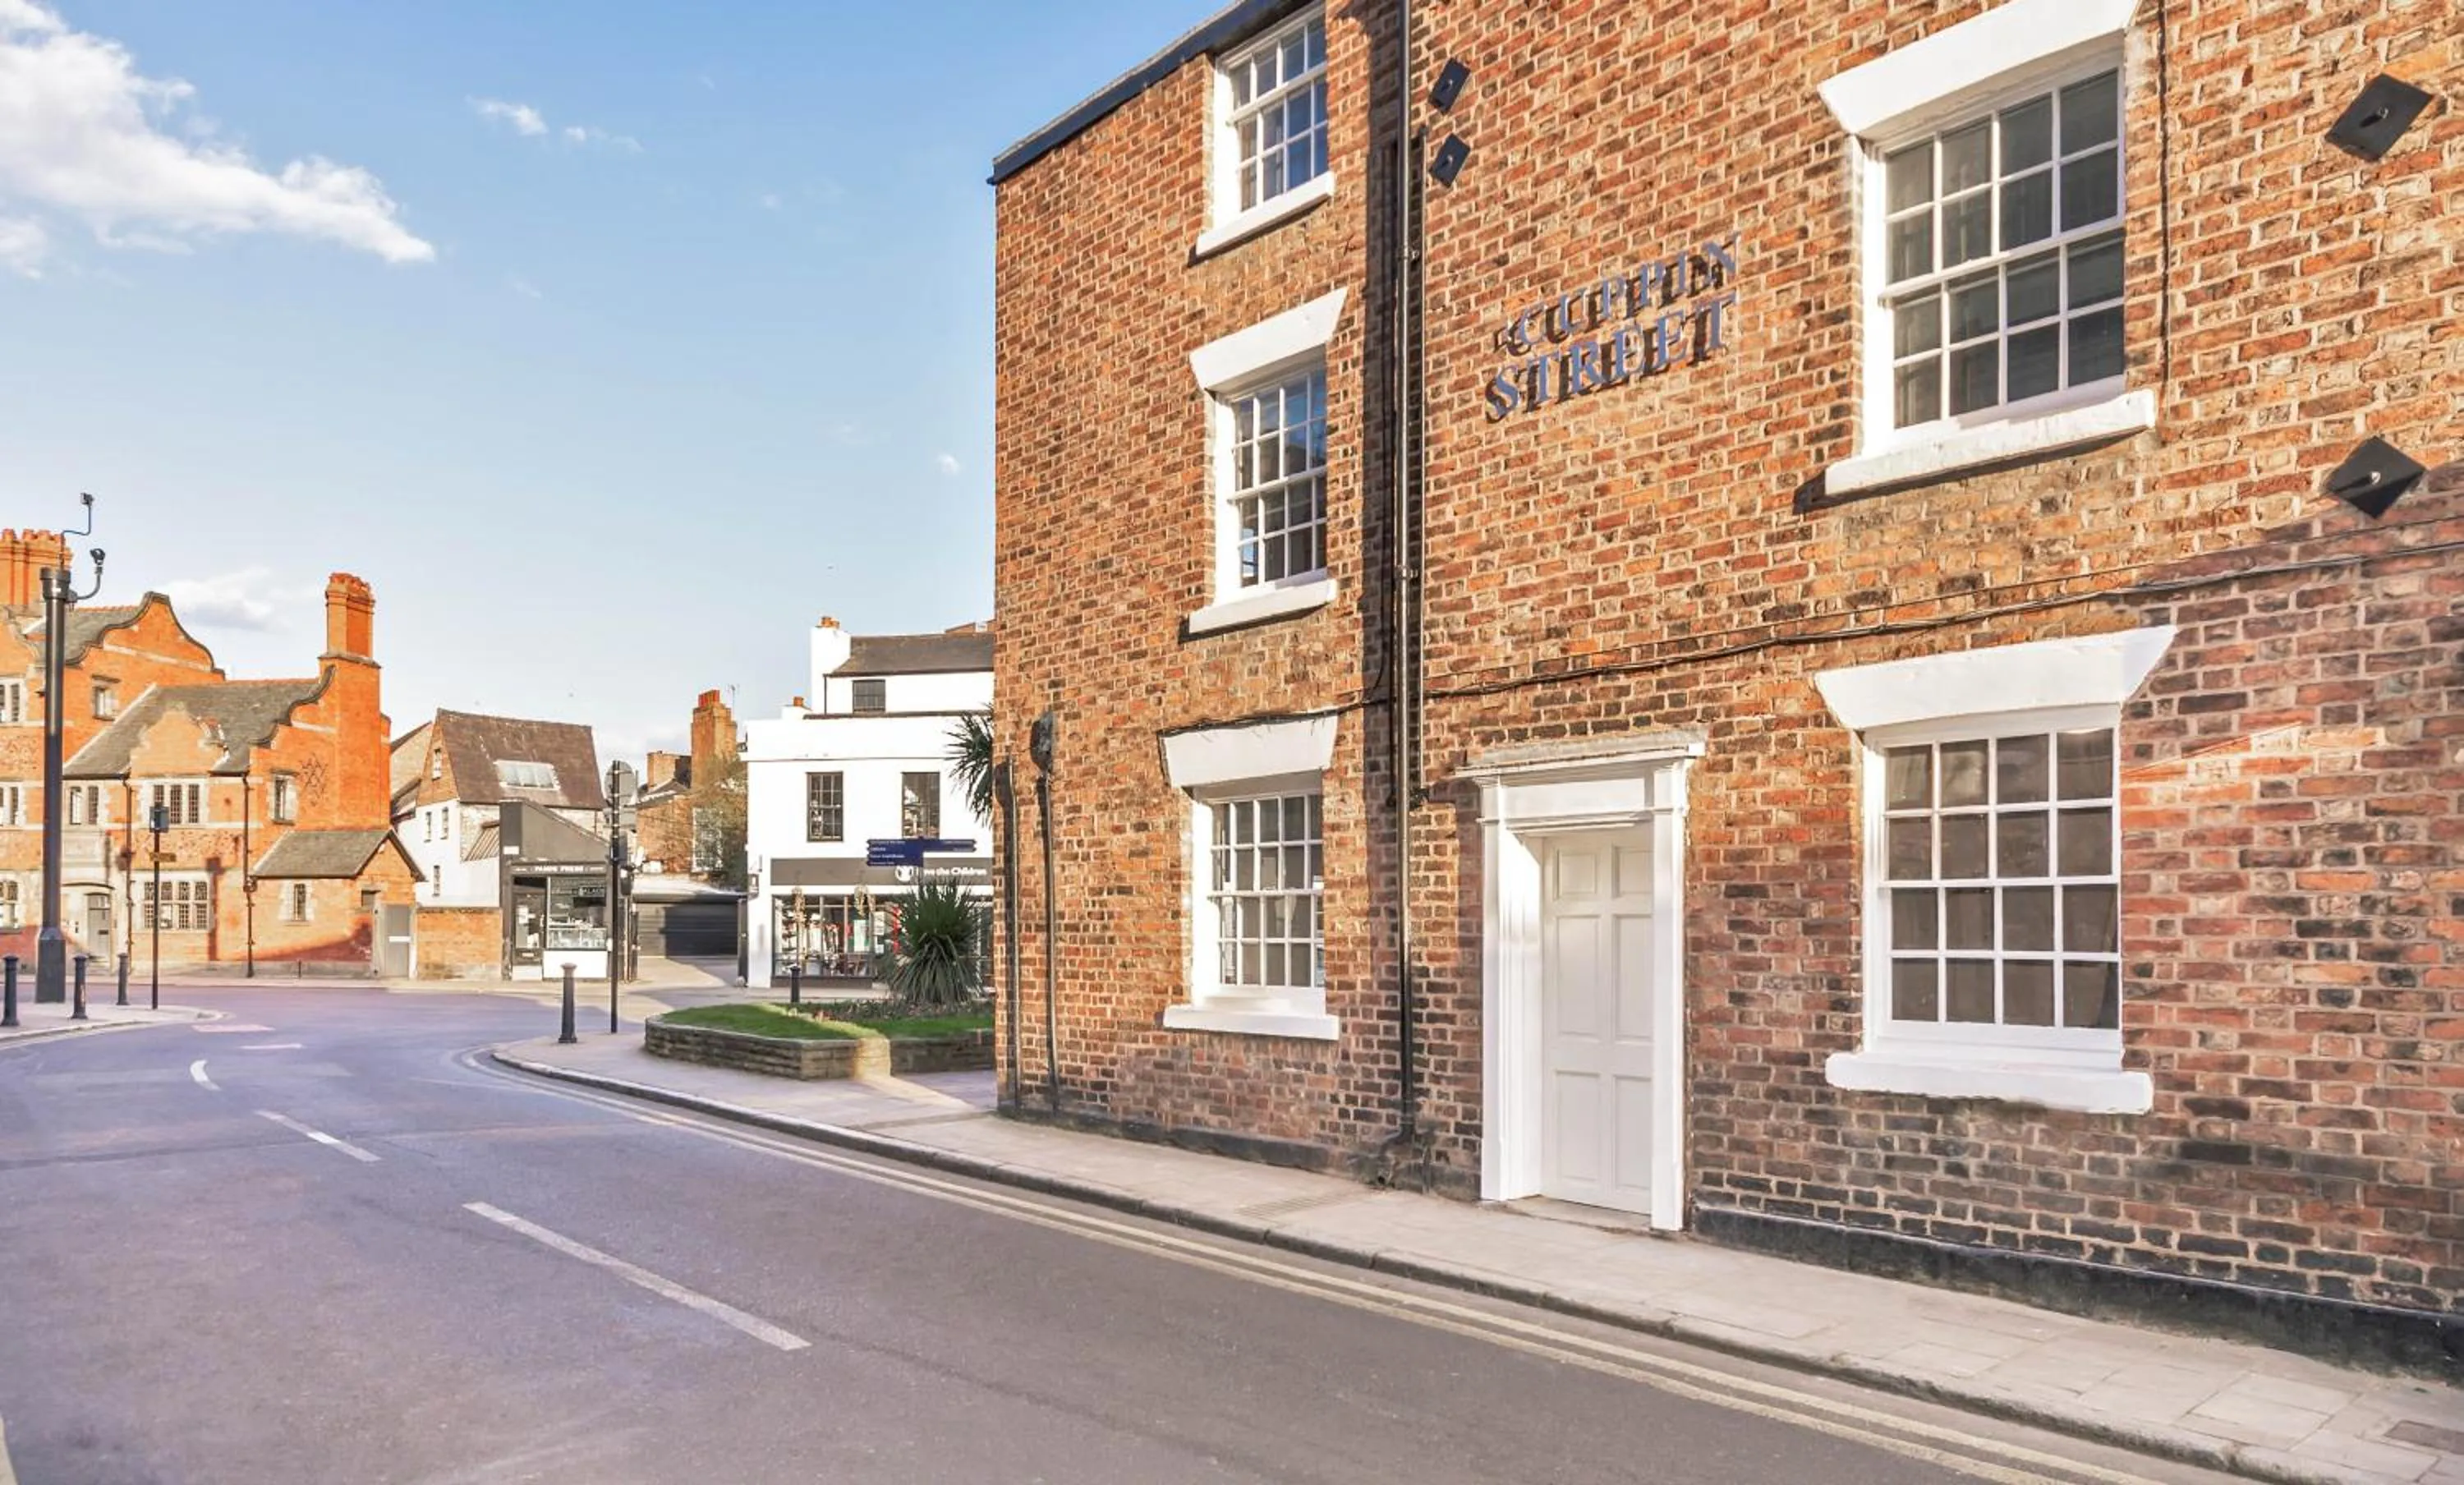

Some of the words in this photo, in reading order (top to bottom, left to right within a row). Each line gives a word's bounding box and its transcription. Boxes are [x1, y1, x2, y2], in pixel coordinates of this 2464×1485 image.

[1510, 232, 1741, 348] CUPPIN
[1487, 292, 1739, 419] STREET
[950, 867, 987, 876] Children
